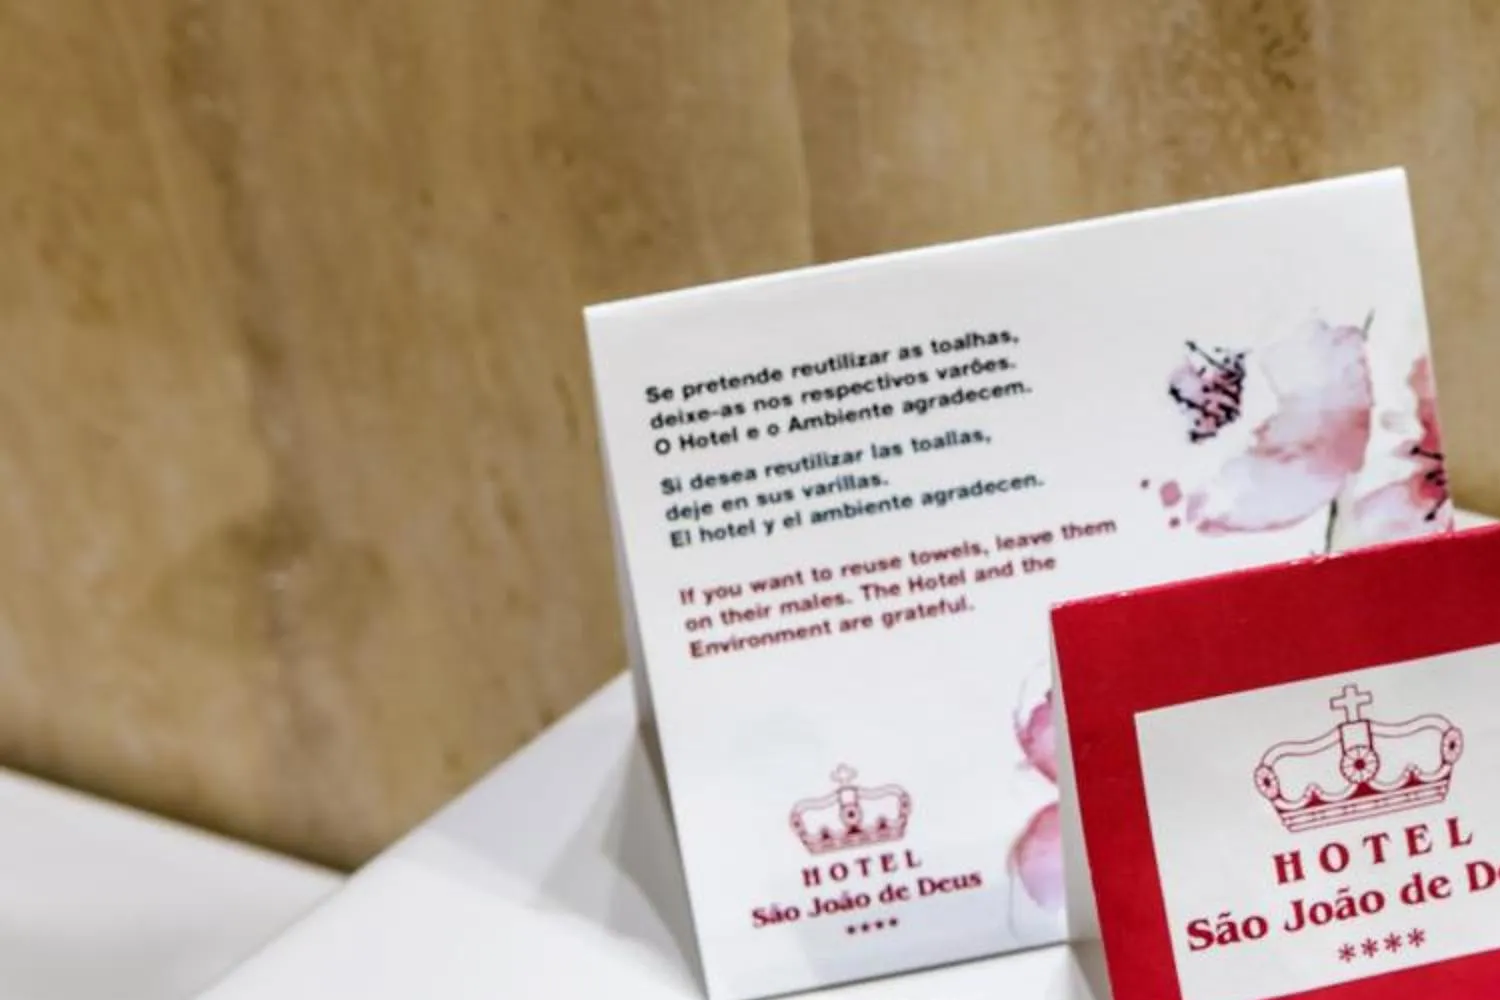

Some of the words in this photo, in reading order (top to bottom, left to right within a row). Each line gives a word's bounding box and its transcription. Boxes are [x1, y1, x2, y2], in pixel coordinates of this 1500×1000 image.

[645, 385, 674, 404] Se
[682, 368, 783, 400] pretende
[791, 350, 890, 378] reutilizar
[898, 345, 924, 361] as
[650, 403, 746, 430] deixe-as
[753, 394, 793, 411] nos
[801, 371, 929, 404] respectivos
[654, 438, 671, 455] O
[679, 426, 738, 450] Hotel
[746, 427, 760, 440] e
[767, 423, 780, 437] o
[788, 402, 894, 432] Ambiente
[660, 476, 682, 495] Si
[689, 468, 757, 490] desea
[764, 449, 863, 478] reutilizar
[871, 443, 903, 460] las
[665, 501, 714, 521] deje
[721, 497, 748, 512] en
[756, 489, 794, 506] sus
[670, 530, 692, 548] El
[699, 518, 755, 543] hotel
[763, 519, 775, 535] y
[782, 511, 802, 529] el
[810, 495, 914, 525] ambiente
[679, 587, 695, 605] If
[703, 584, 743, 605] you
[750, 570, 804, 593] want
[811, 567, 833, 582] to
[840, 556, 902, 577] reuse
[995, 529, 1054, 553] leave
[1061, 519, 1117, 540] them
[684, 615, 713, 632] on
[720, 603, 772, 626] their
[860, 583, 900, 601] The
[908, 569, 966, 593] Hotel
[974, 561, 1014, 583] and
[1021, 556, 1056, 574] the
[689, 620, 832, 659] Environment
[839, 614, 873, 632] are
[802, 849, 922, 888] HOTEL
[1272, 816, 1474, 885] HOTEL
[752, 903, 800, 928] São
[807, 890, 871, 918] João
[878, 883, 911, 904] de
[917, 871, 983, 897] Deus
[1186, 911, 1268, 952] São
[1284, 886, 1385, 933] João
[1400, 873, 1452, 905] de
